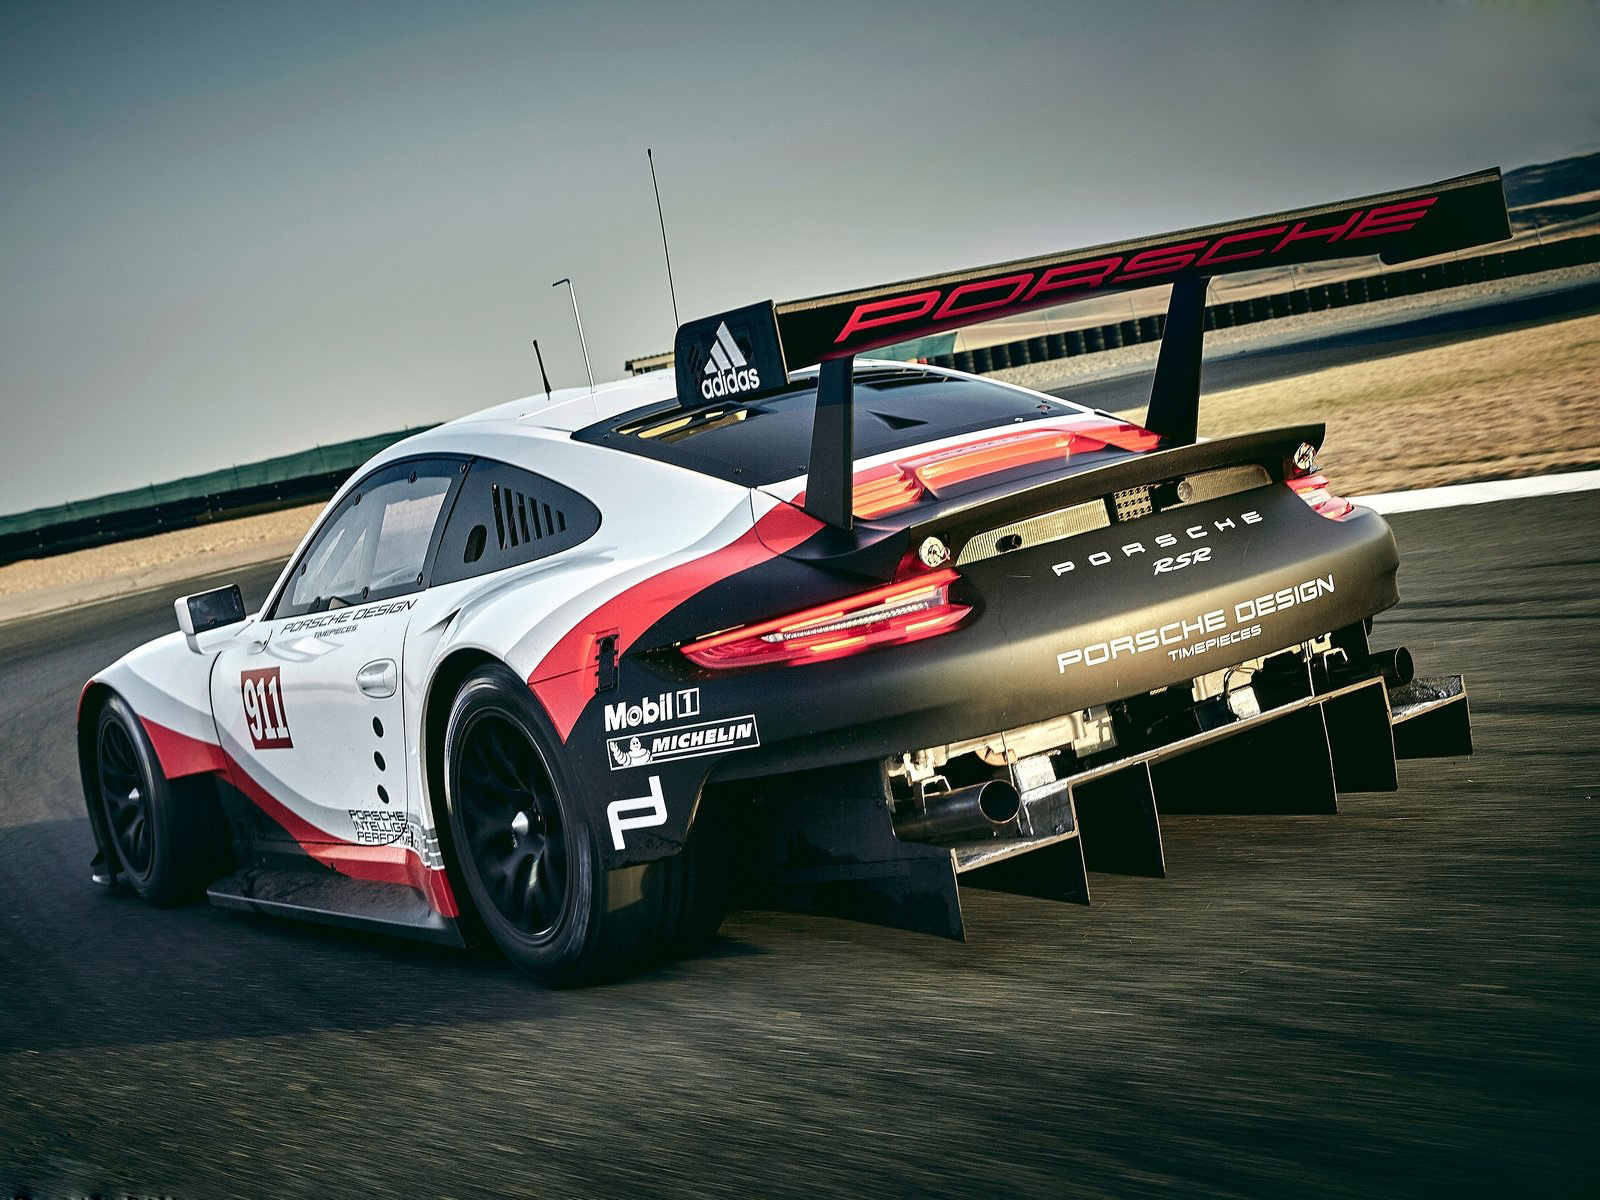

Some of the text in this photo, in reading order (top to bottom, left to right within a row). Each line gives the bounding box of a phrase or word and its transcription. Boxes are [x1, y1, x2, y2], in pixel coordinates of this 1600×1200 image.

[834, 197, 1438, 344] PORSCHE
[701, 366, 760, 399] adidas
[1051, 510, 1263, 577] PORSCHE
[1152, 546, 1212, 576] RSR
[280, 598, 418, 634] PORSCHE DESIGN
[313, 623, 358, 639] TIMEPIECES
[1056, 573, 1335, 674] PORSCHE DESIGN
[1167, 623, 1262, 662] TIMEPIECES
[243, 675, 290, 741] 911
[604, 692, 673, 732] Mobil
[651, 722, 753, 753] MICHELIN
[348, 809, 405, 821] PORSCHE
